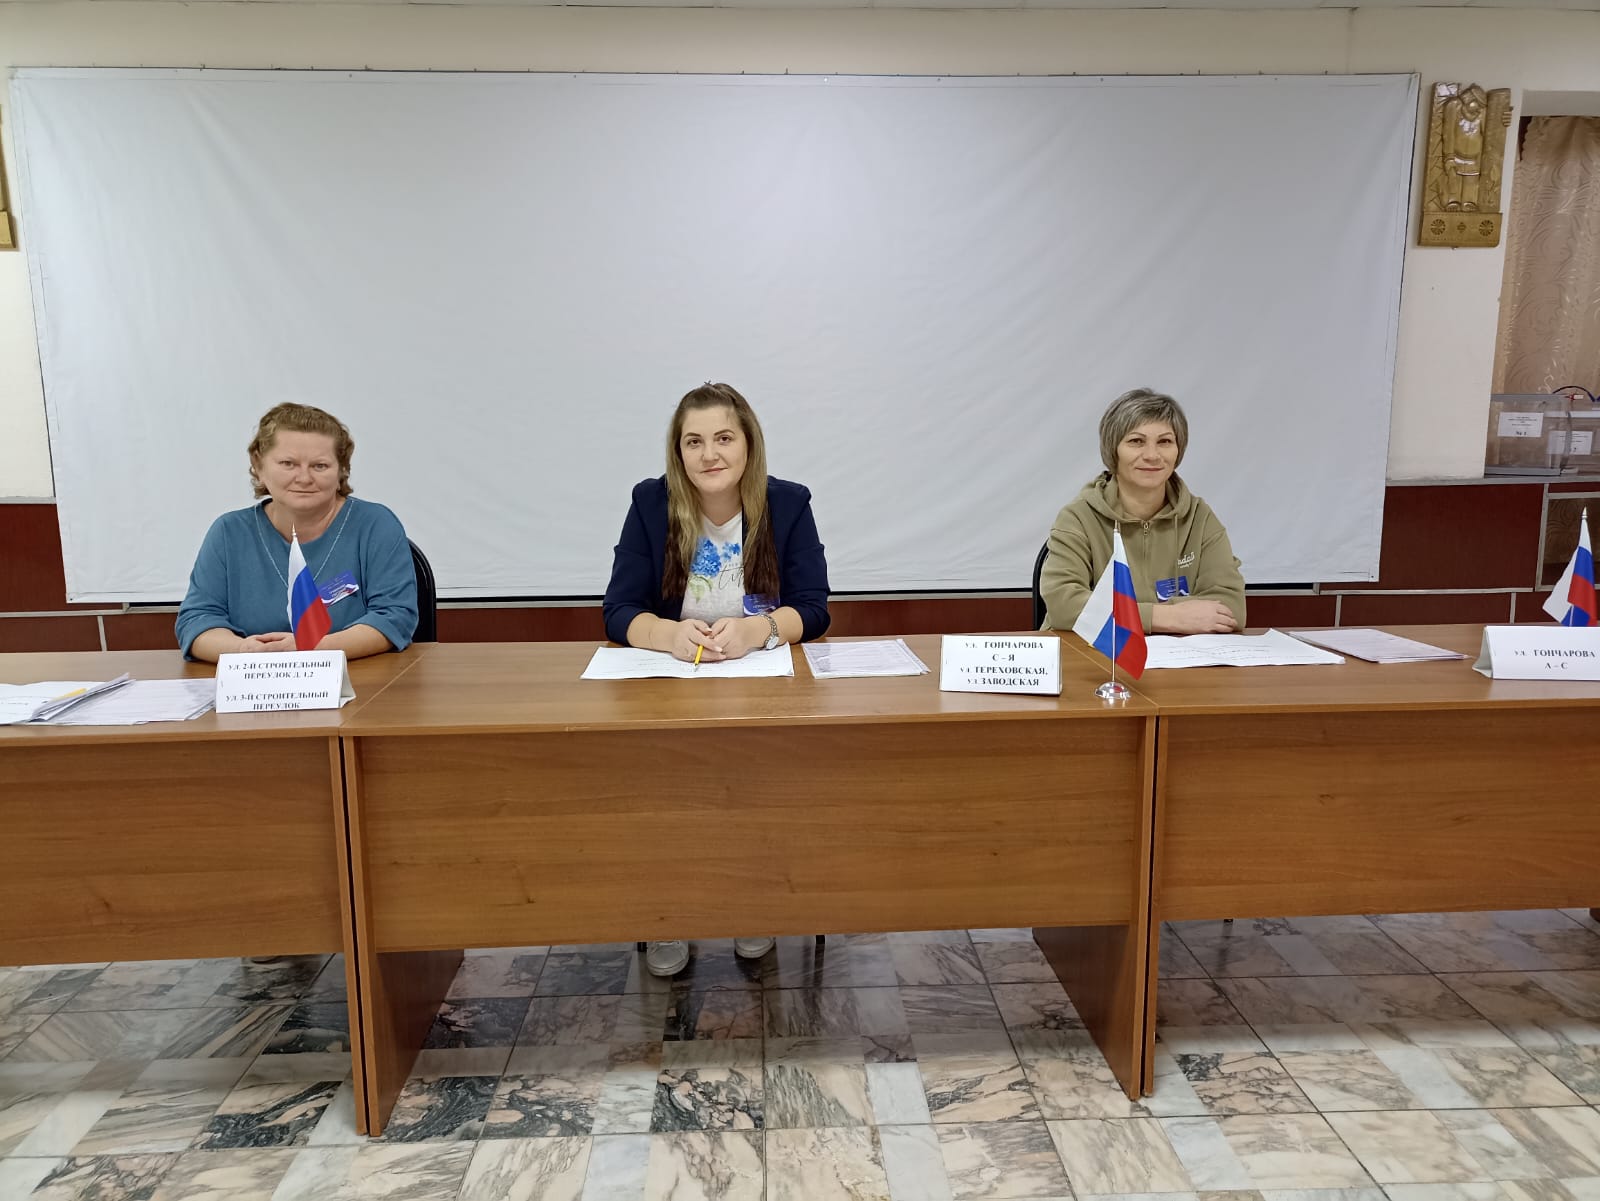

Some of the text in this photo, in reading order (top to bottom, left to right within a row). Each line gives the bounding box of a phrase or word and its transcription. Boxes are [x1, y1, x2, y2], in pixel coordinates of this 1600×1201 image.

[984, 641, 1044, 649] ГОНЧАРОВА
[1533, 649, 1596, 658] ГОНЧАРОВА
[992, 654, 999, 662] С
[1008, 654, 1015, 662] Я
[242, 661, 257, 670] 2-Й
[258, 660, 331, 669] СТРОИТЕЛЬНЫЙ
[1544, 662, 1552, 670] А
[1560, 662, 1569, 670] С
[975, 666, 1048, 675] ТЕРЕХОВСКАЯ,
[244, 672, 291, 680] ПЕРЕУЛОК
[981, 677, 1040, 686] ЗАВОДСКАЯ
[241, 692, 254, 701] 3-Й
[255, 691, 329, 700] СТРОИТЕЛЬНЫЙ
[253, 702, 300, 710] ПЕРЕУЛОК
